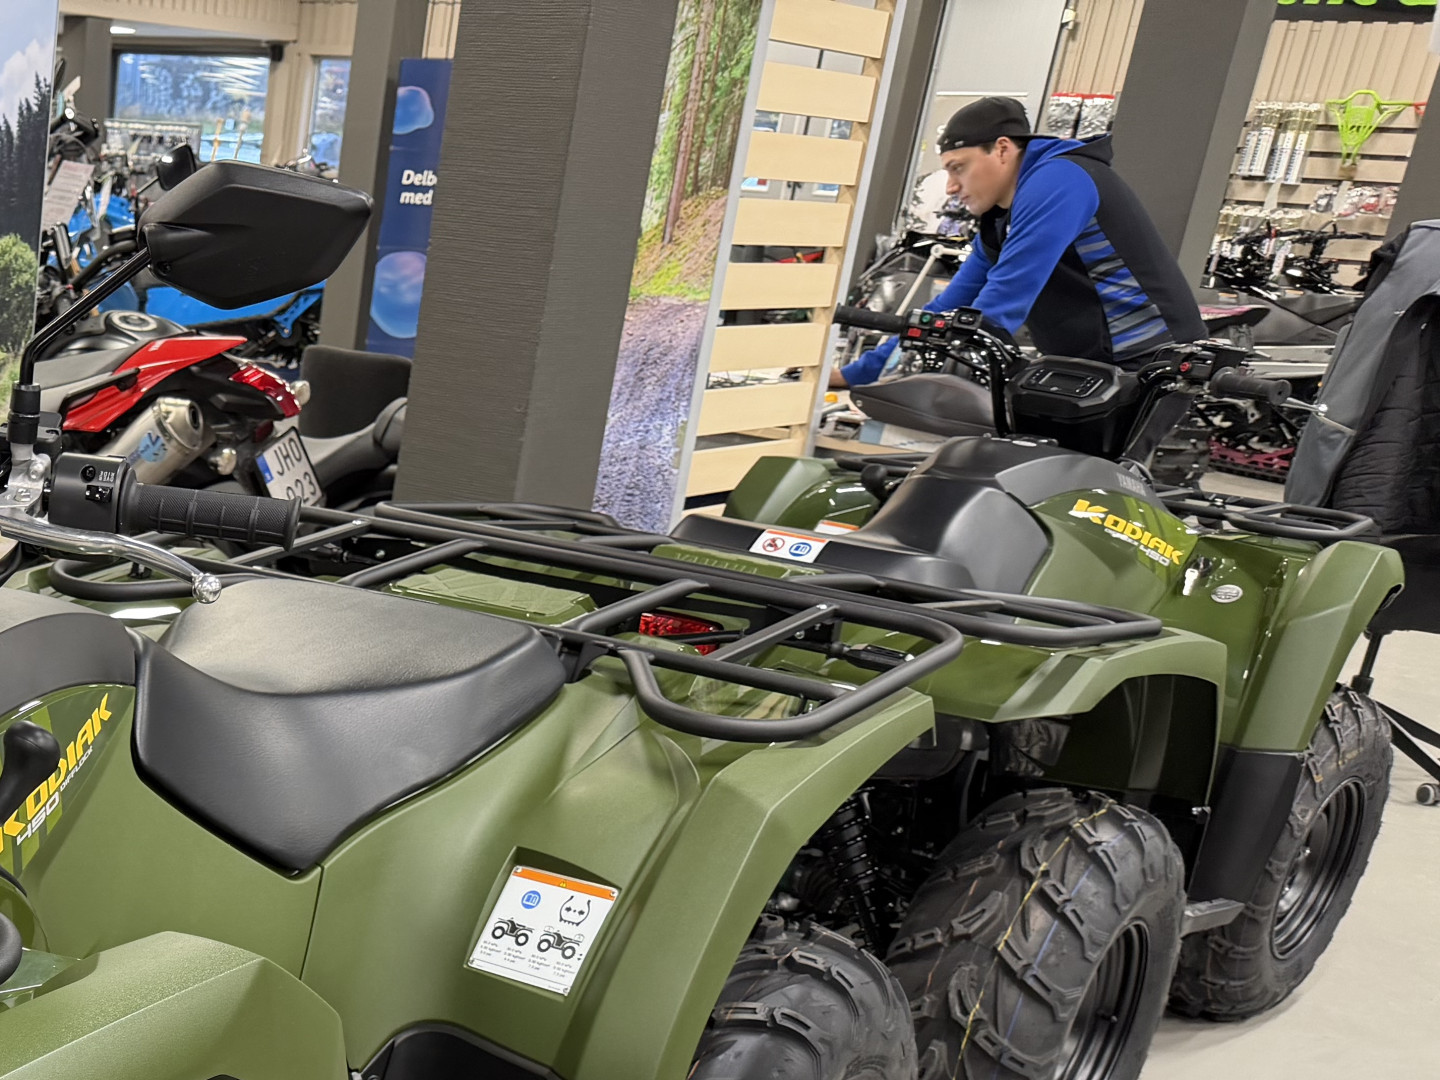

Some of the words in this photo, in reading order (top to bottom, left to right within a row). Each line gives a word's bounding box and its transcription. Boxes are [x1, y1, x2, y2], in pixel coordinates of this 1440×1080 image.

[399, 189, 434, 206] med
[274, 437, 302, 476] JHO
[1069, 499, 1184, 565] KODIAK
[16, 791, 60, 846] 450
[60, 745, 93, 792] DIFFLOCK
